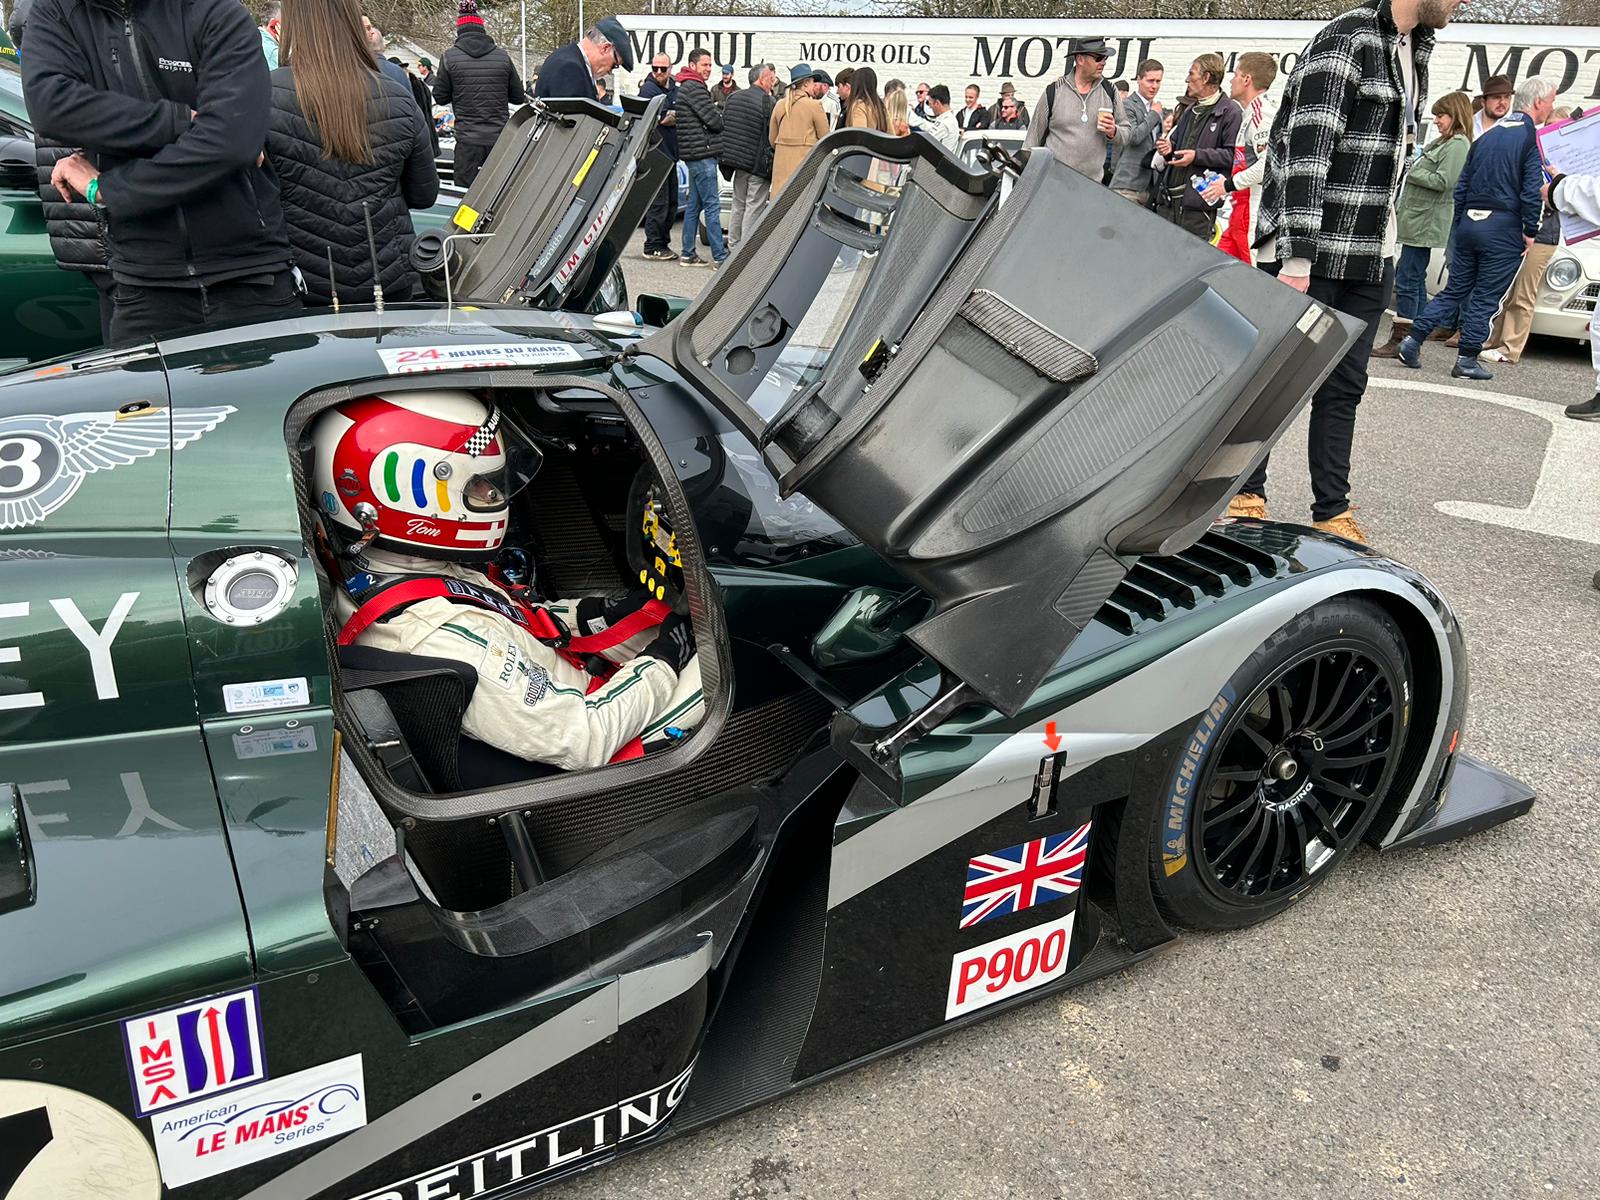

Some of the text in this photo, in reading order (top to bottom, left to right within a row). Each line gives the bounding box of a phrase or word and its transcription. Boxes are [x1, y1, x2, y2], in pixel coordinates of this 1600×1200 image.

[627, 30, 763, 68] MOTUL
[799, 42, 931, 65] MOTOR OILS
[540, 234, 562, 268] Smith
[560, 253, 580, 280] LM
[396, 345, 566, 364] 24 HEURES DU MANS
[406, 518, 441, 537] Tom
[1168, 695, 1230, 830] MICHELIN
[1278, 782, 1314, 811] RACING
[956, 928, 1066, 1006] P900
[139, 1022, 177, 1105] IMSA
[161, 1103, 238, 1134] American
[195, 1104, 309, 1158] LE MANS
[274, 1121, 325, 1145] Series
[365, 1069, 694, 1200] EITLING
